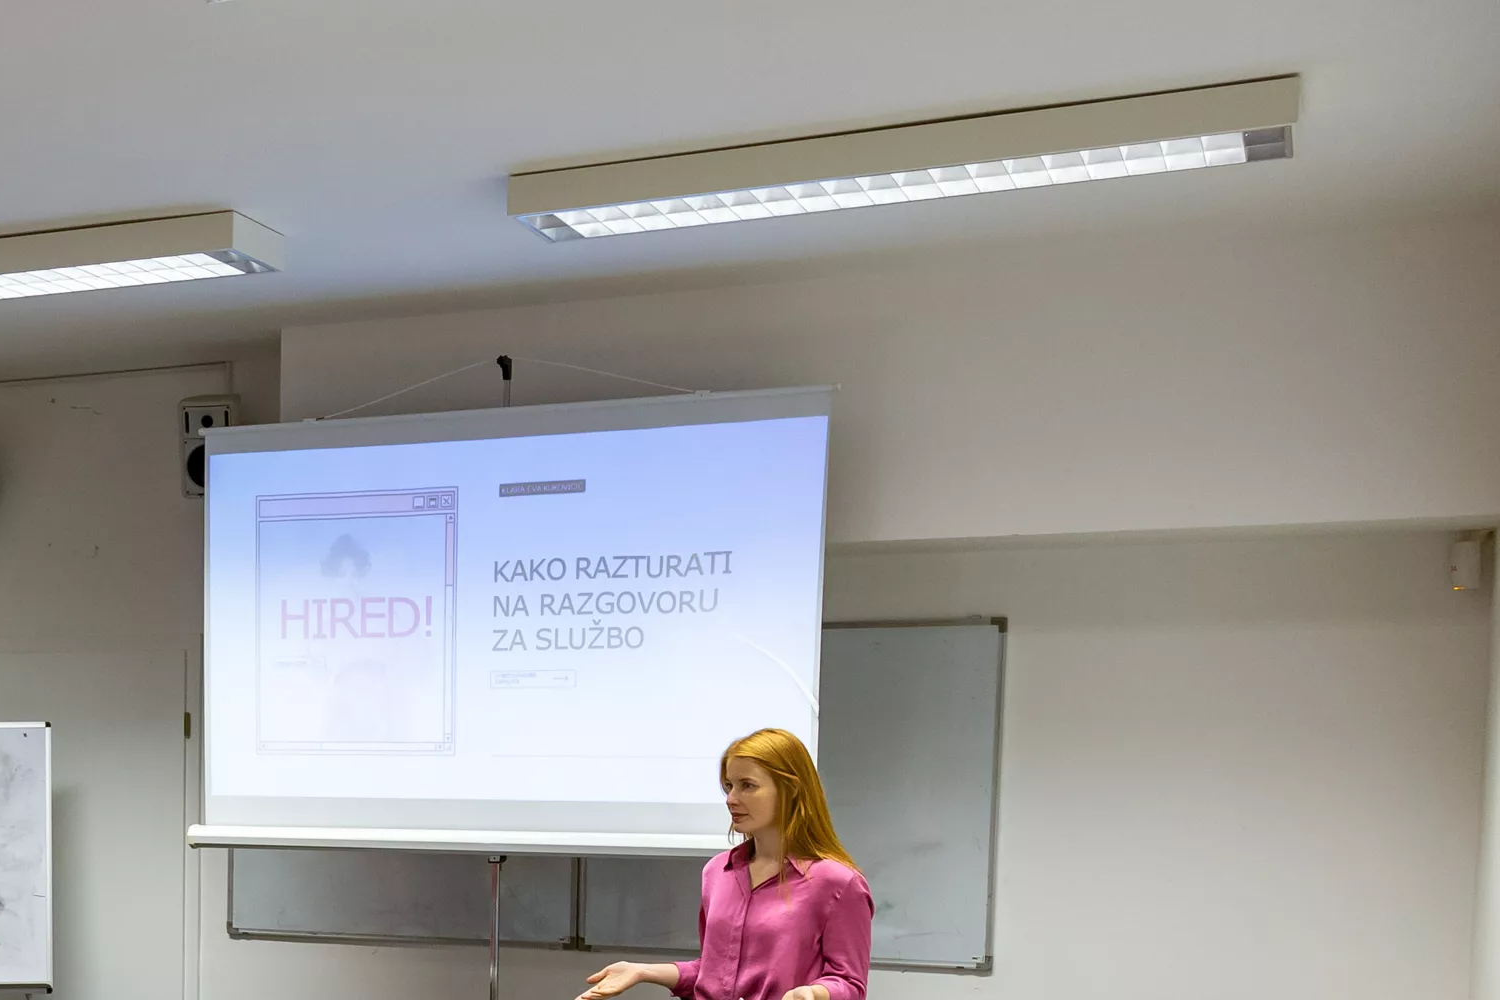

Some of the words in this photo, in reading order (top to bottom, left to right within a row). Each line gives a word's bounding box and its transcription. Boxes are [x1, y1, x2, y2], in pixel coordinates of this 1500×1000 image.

[493, 557, 567, 583] KAKO
[575, 550, 733, 580] RAZTURATI
[280, 595, 432, 640] HIRED!
[493, 594, 530, 618] NA
[540, 588, 719, 616] RAZGOVORU
[492, 629, 528, 652] ZA
[535, 619, 645, 651] SLUŽBO
